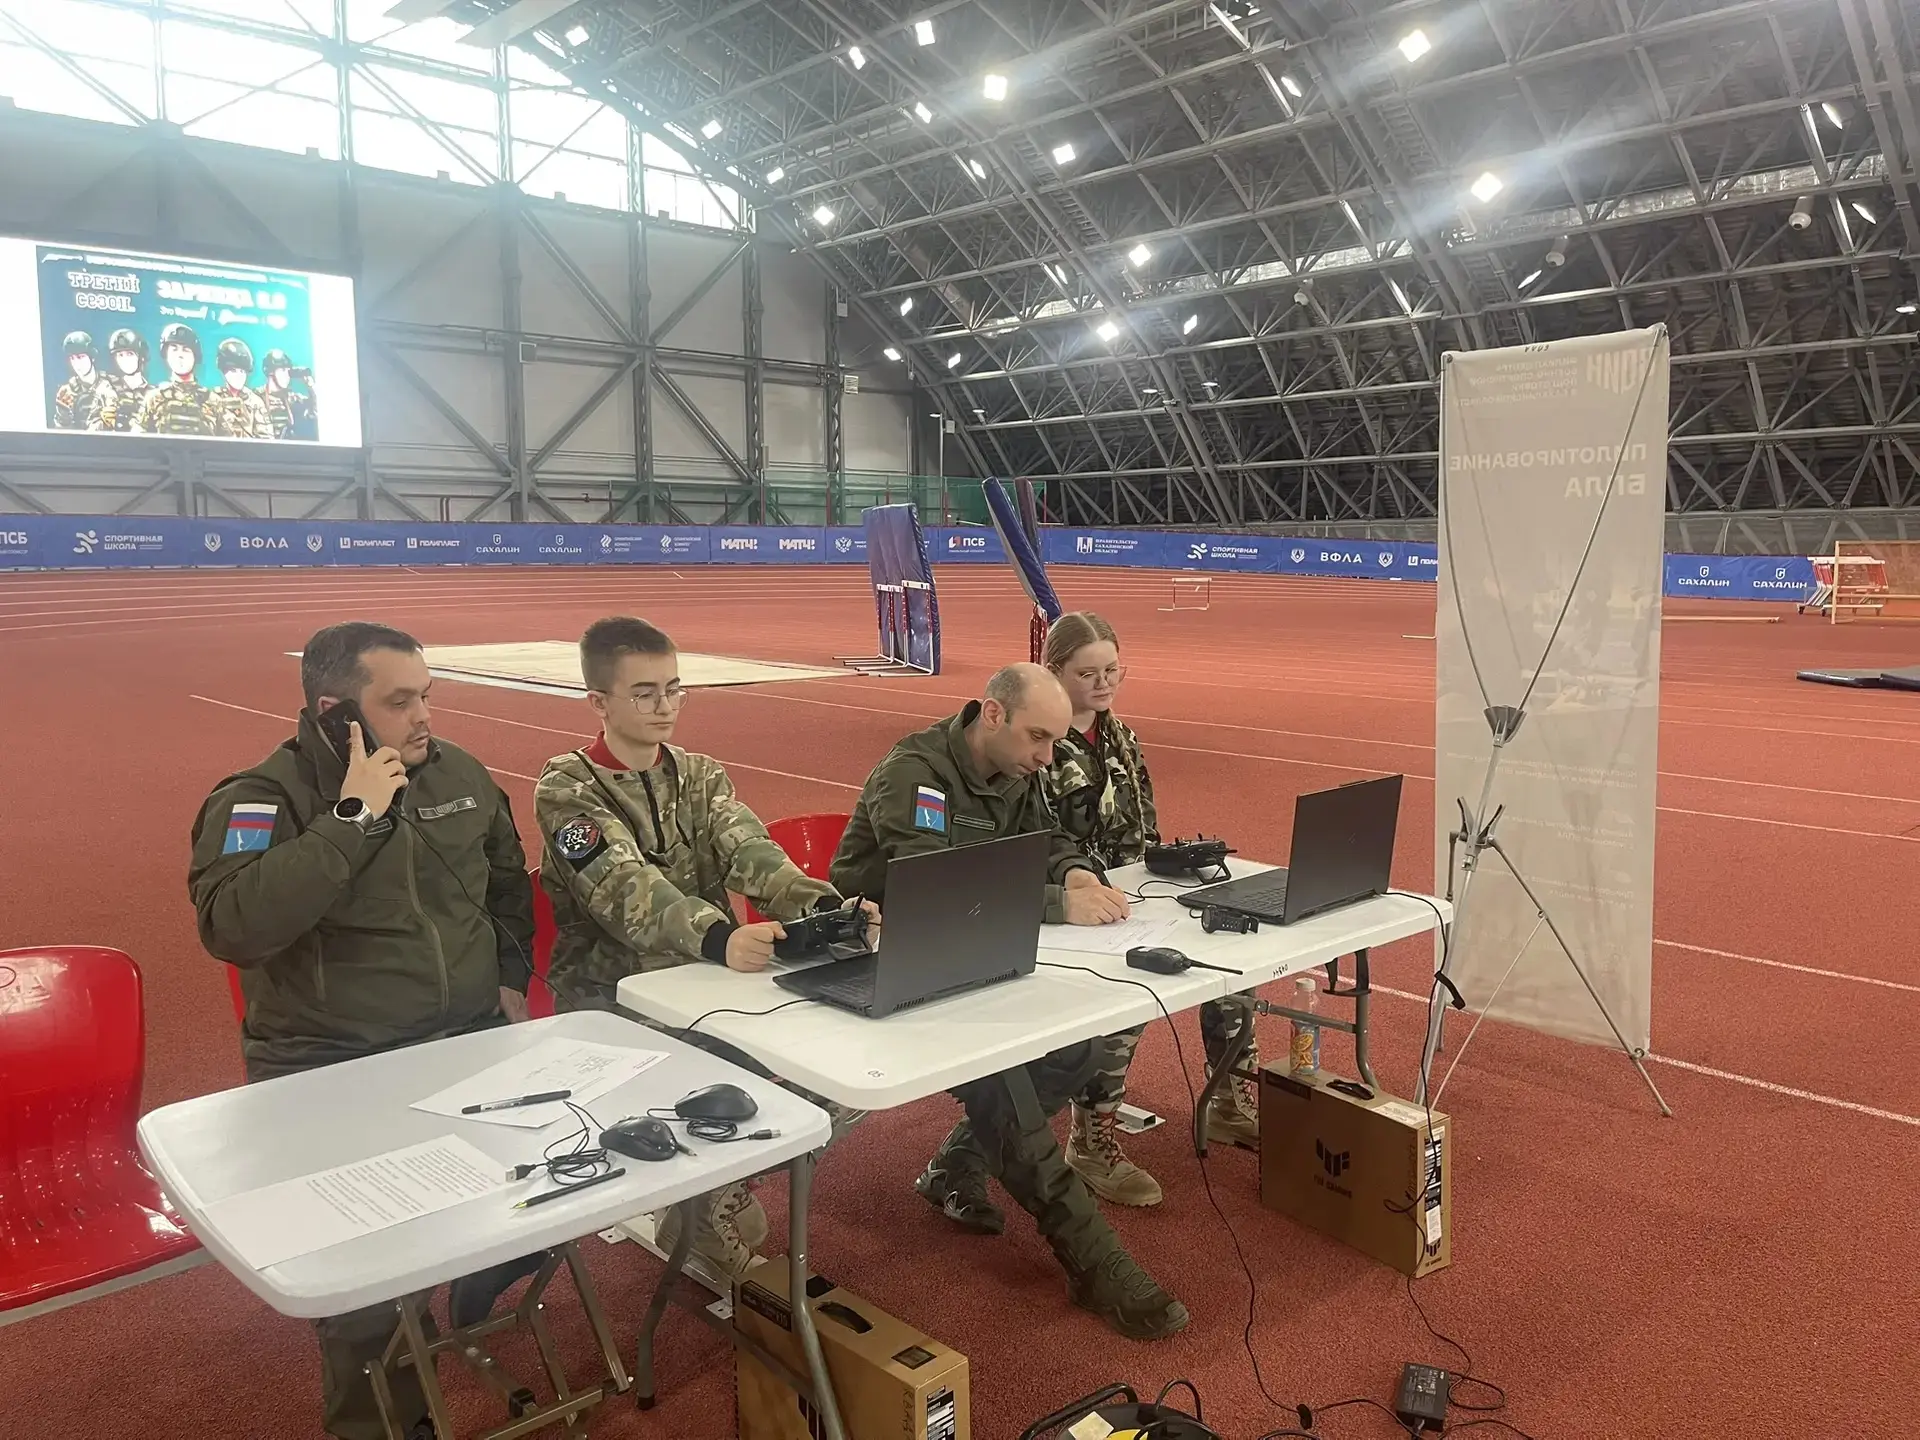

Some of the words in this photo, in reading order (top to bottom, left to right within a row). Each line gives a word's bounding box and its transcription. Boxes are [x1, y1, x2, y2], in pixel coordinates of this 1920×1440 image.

[68, 269, 140, 293] ТРЕТИЙ
[104, 535, 164, 543] СПОРТИВНАЯ
[240, 536, 289, 549] ВФЛА
[721, 538, 757, 550] МАТЧ!
[779, 538, 816, 550] МАТЧ!
[963, 537, 986, 547] ПСБ
[1211, 546, 1259, 554] СПОРТИВНАЯ
[1320, 551, 1363, 564] ВФЛА
[1678, 578, 1730, 587] САХАЛИН
[1753, 580, 1808, 589] САХАЛИН
